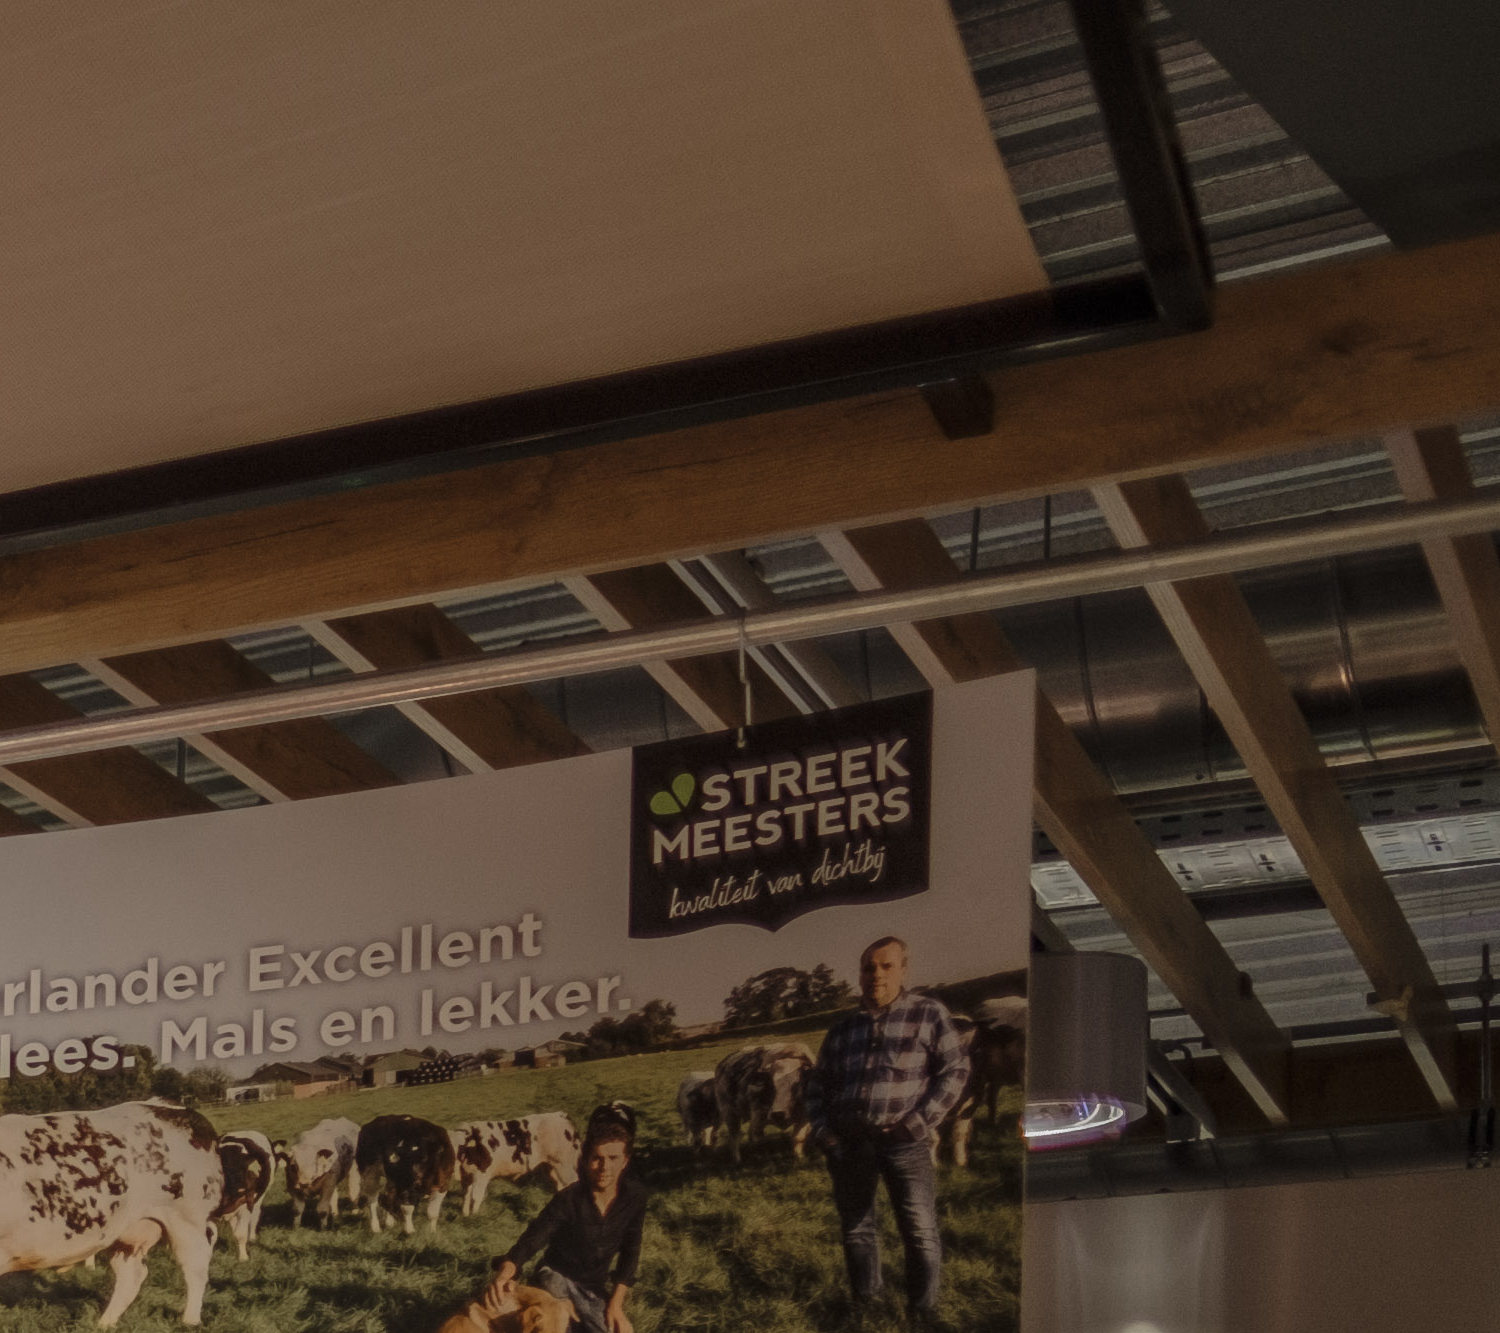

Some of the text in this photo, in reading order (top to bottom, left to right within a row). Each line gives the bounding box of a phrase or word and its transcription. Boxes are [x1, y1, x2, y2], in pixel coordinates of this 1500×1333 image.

[700, 738, 911, 811] STREEK
[653, 786, 911, 865] MEESTERS
[668, 840, 886, 920] kwaliteit van dichtbij
[248, 912, 543, 991] Excellent
[161, 1001, 299, 1067] Mals
[319, 1001, 396, 1049] en
[419, 970, 632, 1037] lekker.
